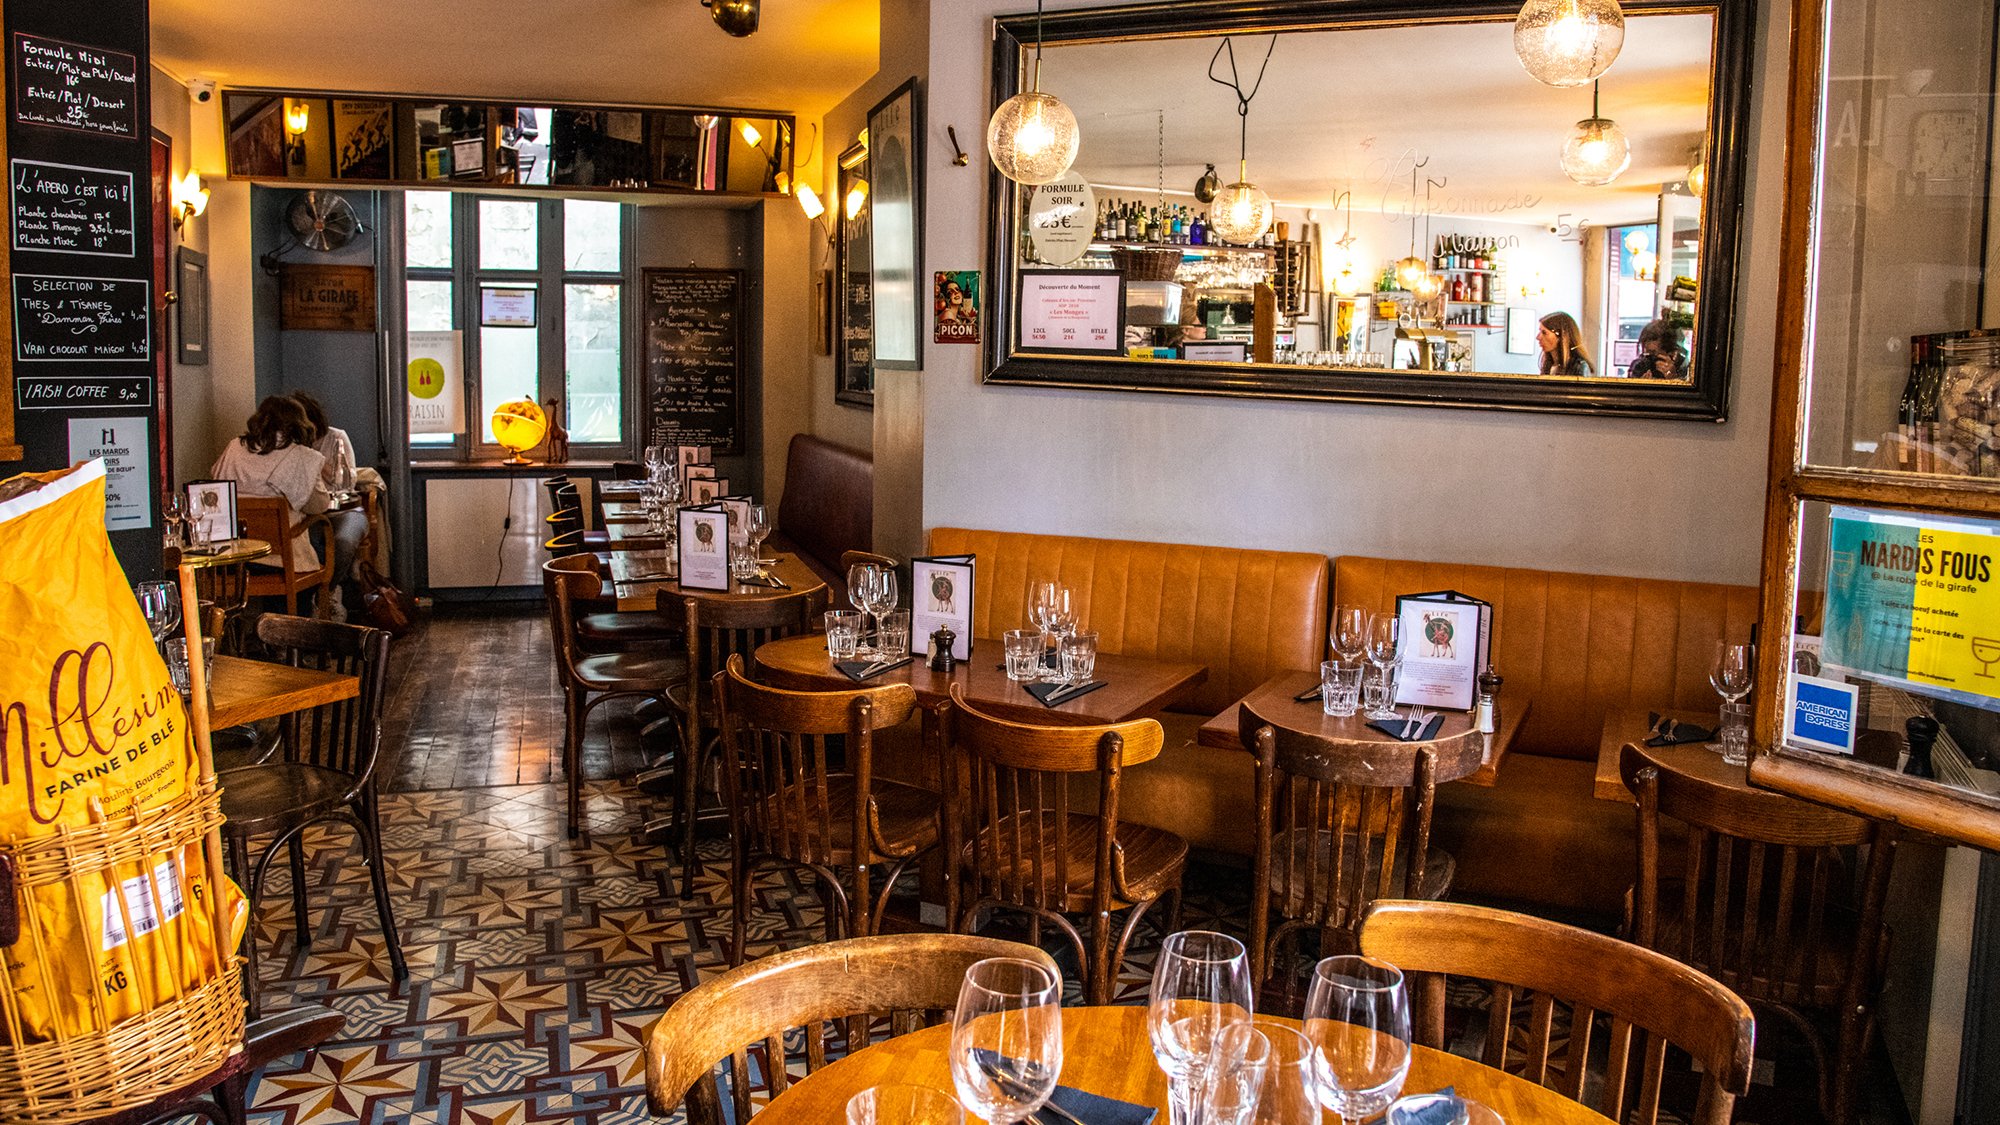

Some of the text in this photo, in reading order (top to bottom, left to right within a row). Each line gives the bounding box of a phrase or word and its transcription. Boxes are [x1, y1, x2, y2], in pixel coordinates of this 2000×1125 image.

[23, 41, 73, 60] Formule
[1041, 184, 1084, 193] FORMULE
[1051, 196, 1073, 205] SOIR
[33, 280, 116, 291] SELECTION DE
[319, 289, 358, 304] GIRAFE
[21, 298, 50, 310] THES
[941, 325, 972, 336] PICON
[23, 342, 45, 355] VRAI
[50, 345, 88, 354] CHOCOLAT
[25, 384, 62, 398] IRISH
[66, 385, 109, 398] COFFEE
[89, 448, 101, 456] LES
[1916, 534, 1934, 544] LES
[1860, 540, 1991, 583] MARDIS FOUS
[1920, 578, 1934, 588] de
[1935, 579, 1945, 589] la
[1946, 581, 1977, 595] girafe
[1931, 607, 1960, 618] achetée
[1923, 626, 1931, 634] la
[1932, 628, 1951, 637] carte
[1952, 632, 1965, 640] des
[1796, 700, 1848, 720] AMERICAN
[1805, 713, 1850, 732] EXPRESS
[0, 641, 176, 825] Millésim
[45, 717, 175, 798] FARINE DE BLÉ
[135, 758, 175, 789] Bourgeois
[104, 971, 128, 996] KG
